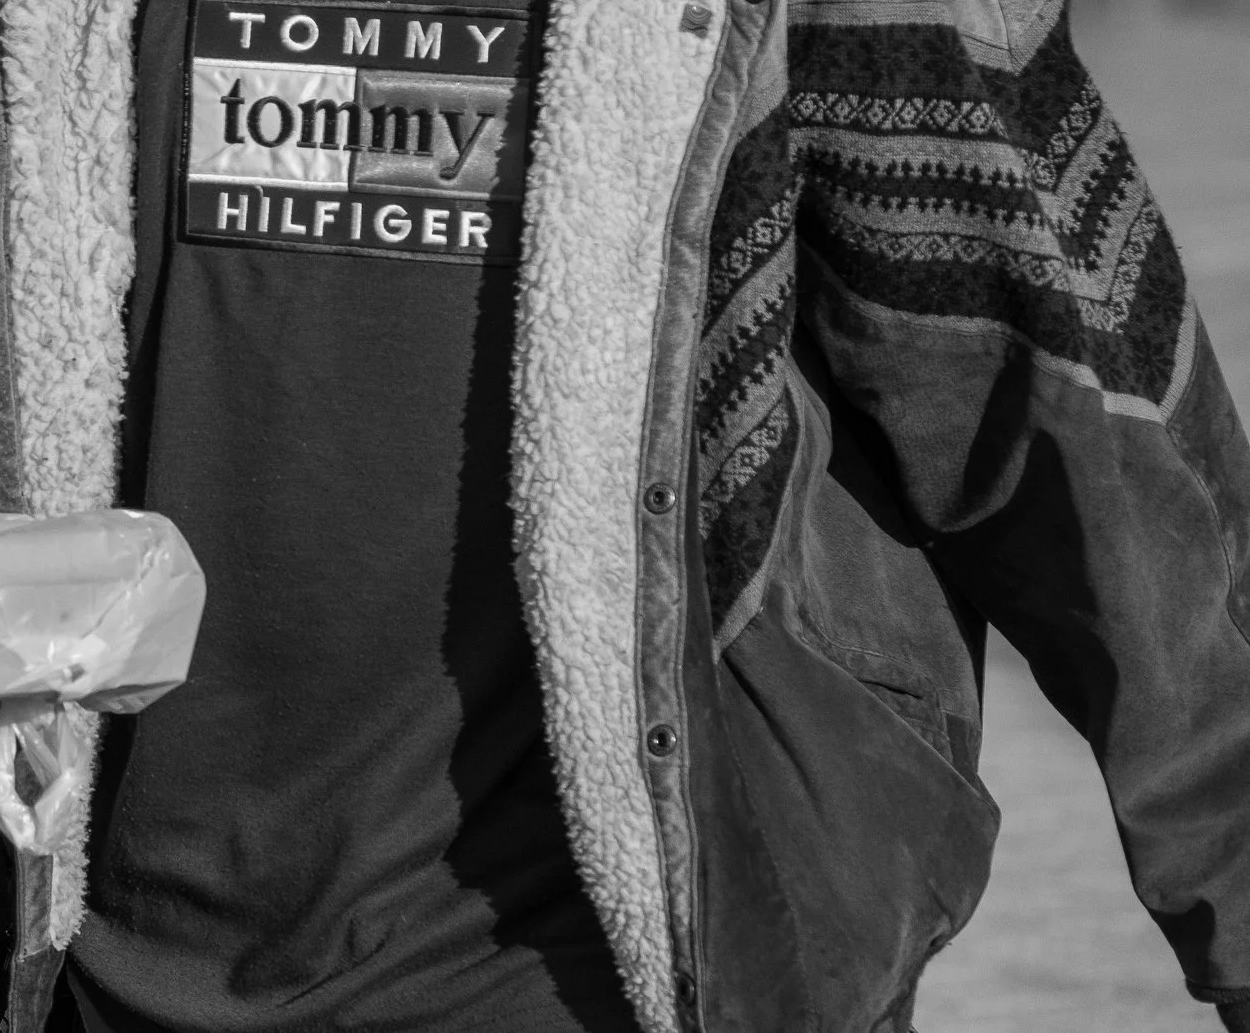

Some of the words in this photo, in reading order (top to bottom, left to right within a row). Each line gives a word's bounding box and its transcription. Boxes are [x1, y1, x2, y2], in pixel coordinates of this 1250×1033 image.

[228, 11, 506, 64] TOMMY
[220, 77, 497, 181] tommy
[216, 191, 493, 249] HILFIGER
